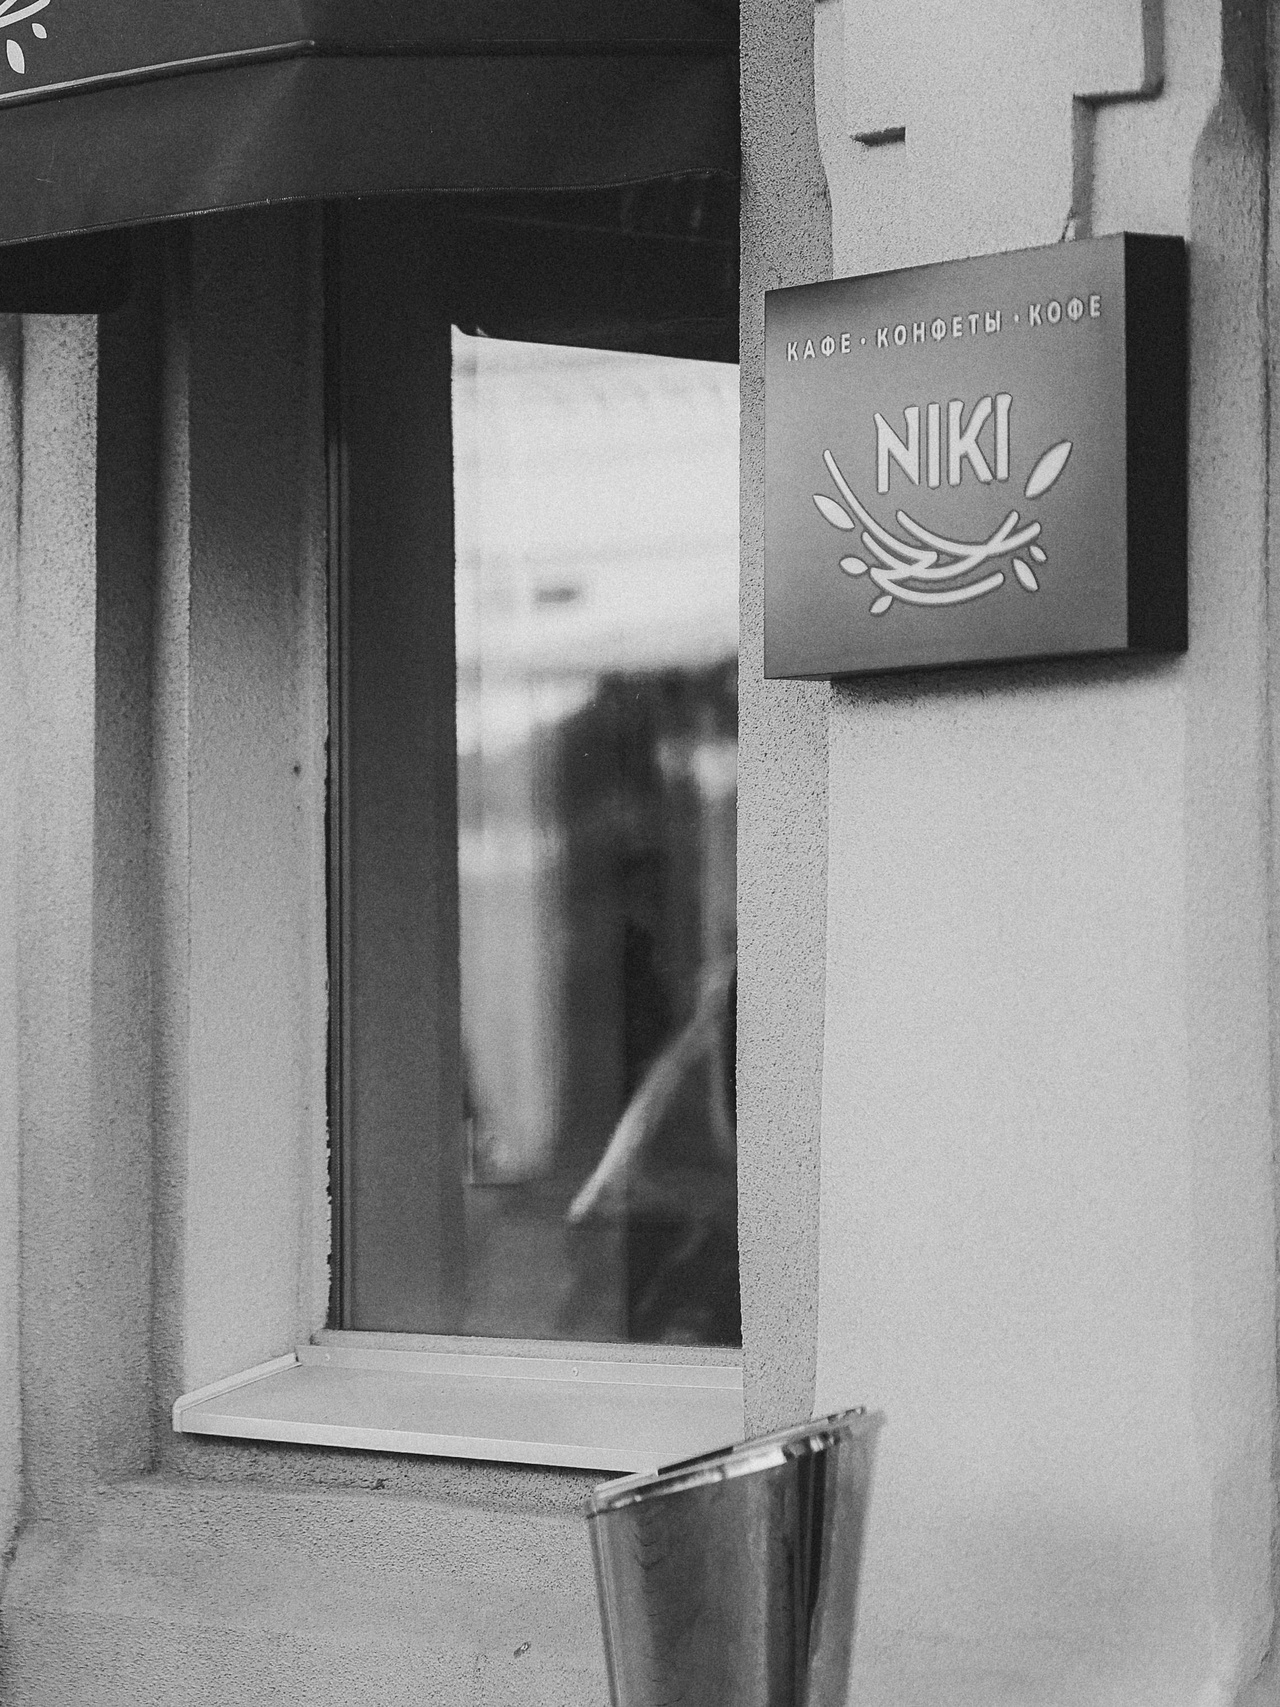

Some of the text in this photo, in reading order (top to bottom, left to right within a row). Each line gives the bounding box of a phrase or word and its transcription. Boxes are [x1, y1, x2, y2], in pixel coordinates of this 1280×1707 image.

[787, 295, 1102, 362] КАФЕ КОНФЕТЫ КОФЕ
[873, 392, 1013, 494] NIKI
